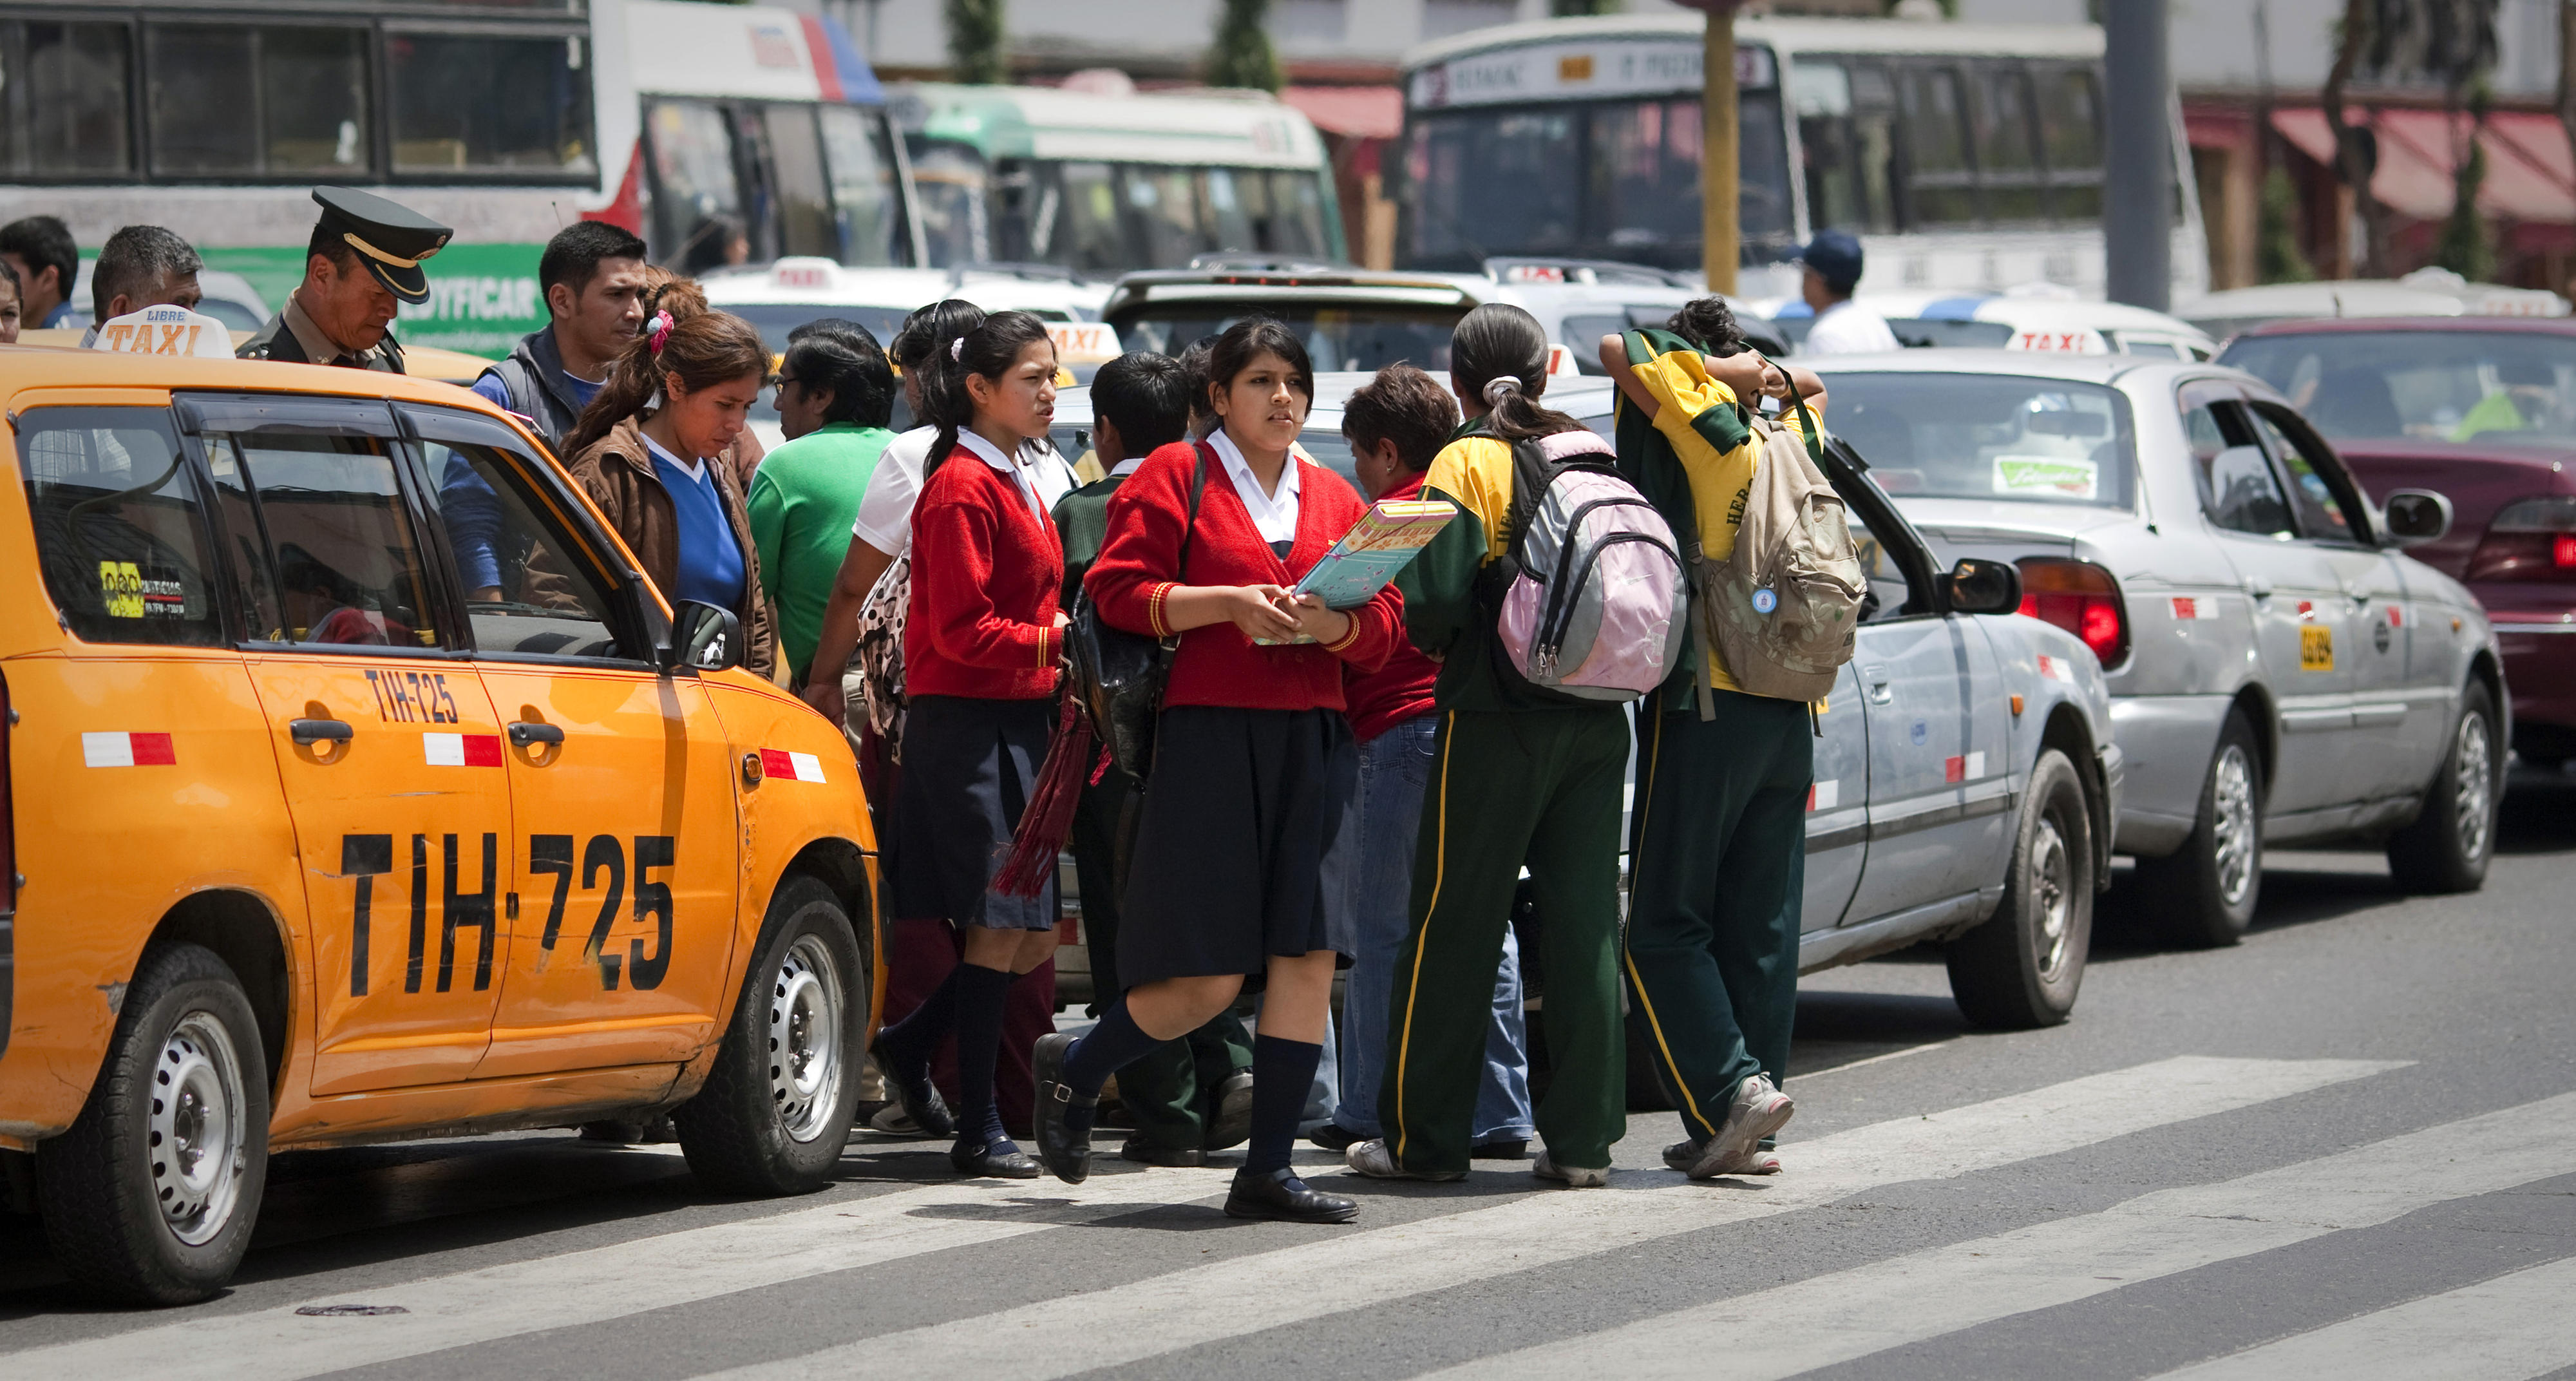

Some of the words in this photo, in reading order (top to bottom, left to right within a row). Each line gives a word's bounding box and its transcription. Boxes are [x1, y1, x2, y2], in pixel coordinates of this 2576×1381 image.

[147, 310, 186, 321] LIBRE
[106, 325, 201, 356] TAXI
[2023, 334, 2086, 352] TAXI
[364, 670, 458, 723] TIH-725
[341, 833, 674, 996] TIH-725
